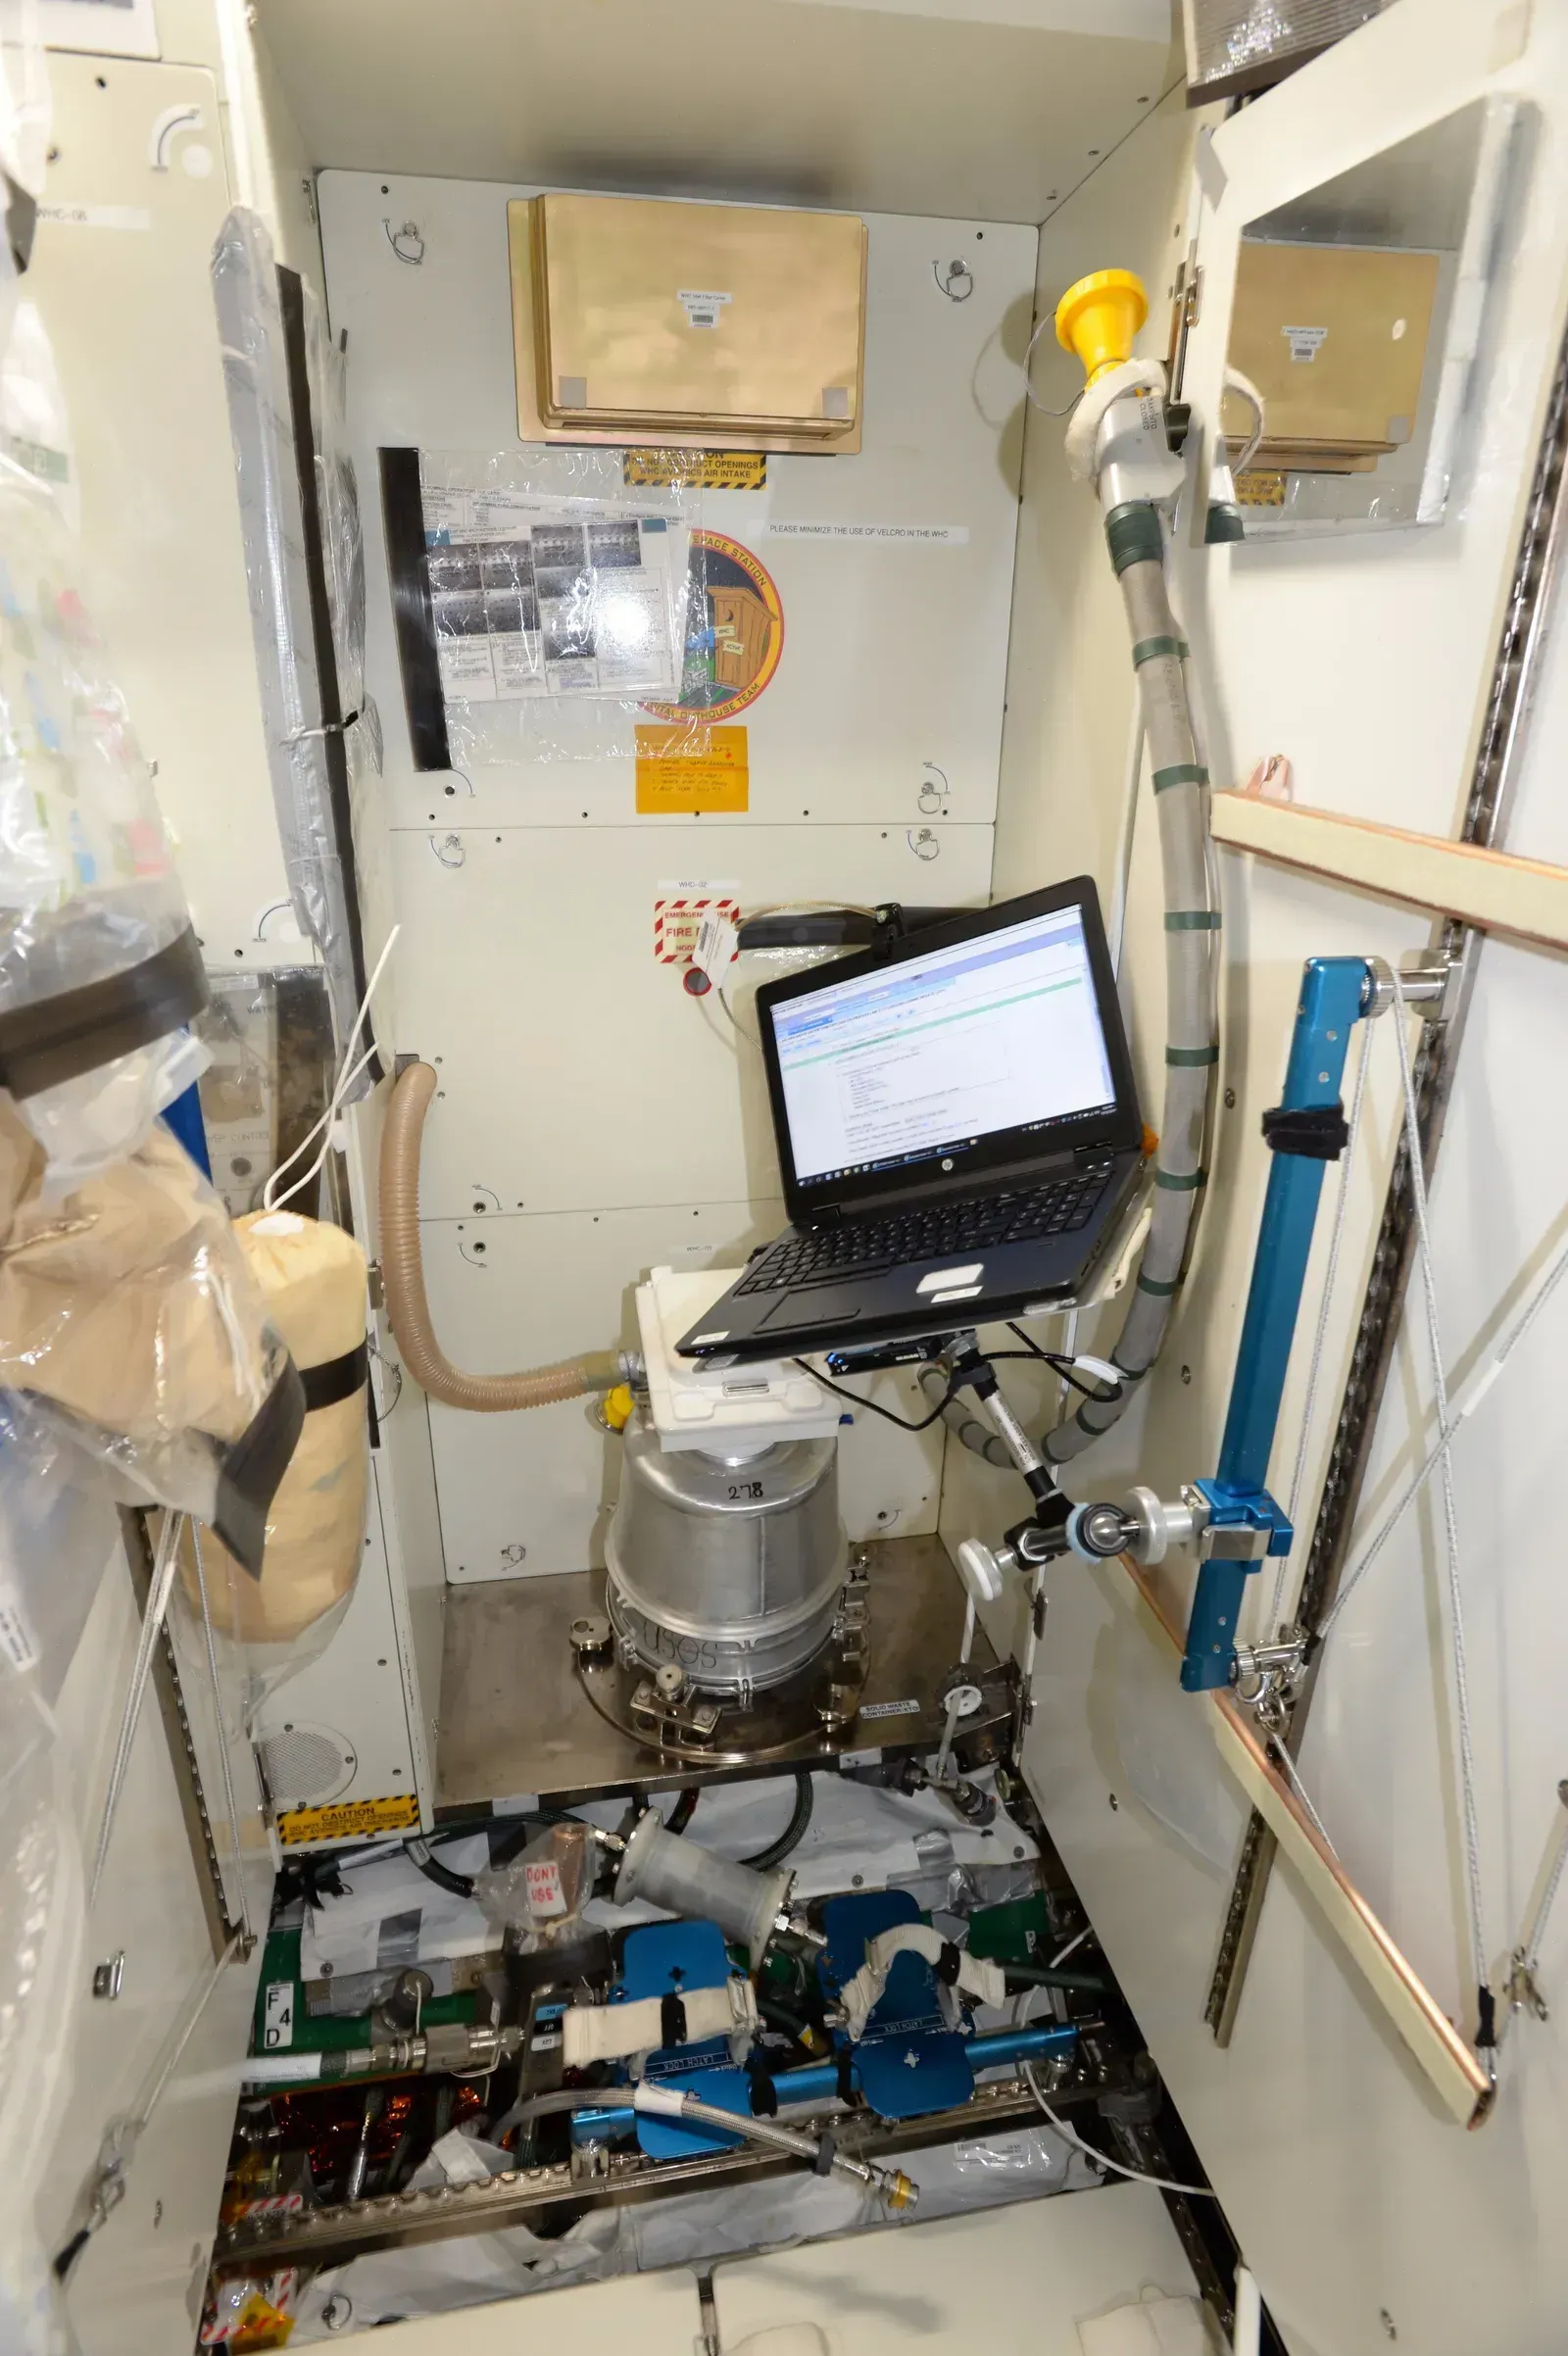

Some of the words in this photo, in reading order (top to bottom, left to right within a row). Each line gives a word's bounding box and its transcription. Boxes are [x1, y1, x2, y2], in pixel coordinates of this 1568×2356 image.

[1140, 403, 1150, 431] CLOSED
[714, 461, 759, 469] OPENINGS
[640, 466, 660, 475] WHC
[720, 470, 752, 479] INTAKE
[769, 524, 799, 533] PLEASE
[800, 525, 832, 534] MINIMIZE
[833, 526, 848, 535] THE
[849, 527, 863, 536] USE
[865, 527, 875, 536] OF
[877, 528, 906, 537] VELCRO
[915, 529, 931, 538] THE
[730, 548, 767, 587] STATION
[736, 682, 760, 705] TEAM
[665, 926, 693, 938] FIRE
[728, 1481, 763, 1499] 278
[862, 1708, 902, 1718] CONTAINER
[320, 1806, 375, 1822] CAUTION
[321, 1816, 366, 1828] OBSTRUCT
[531, 1887, 554, 1903] USE
[268, 1991, 279, 2010] F
[279, 2007, 291, 2026] 4
[883, 2023, 901, 2034] LOCK
[903, 2019, 923, 2030] LATCH
[267, 2029, 280, 2047] D
[662, 2060, 685, 2072] LOCK
[687, 2055, 714, 2067] LATCH
[719, 2063, 738, 2073] Unlock
